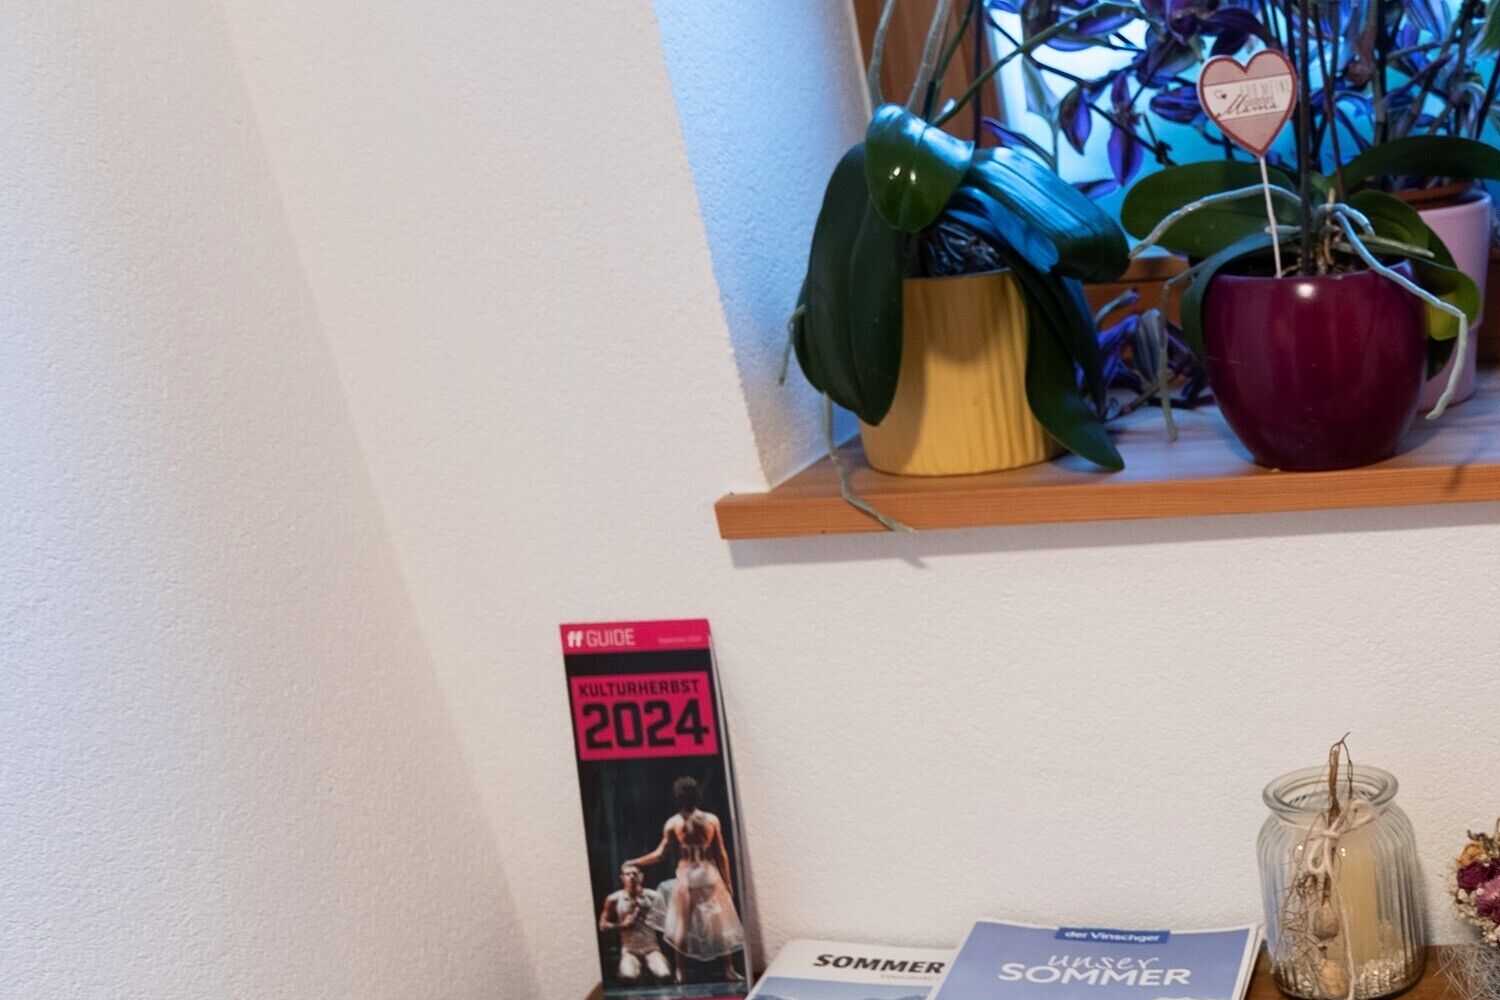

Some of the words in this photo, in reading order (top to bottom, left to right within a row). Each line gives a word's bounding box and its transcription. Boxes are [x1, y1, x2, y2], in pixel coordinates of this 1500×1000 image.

[585, 628, 636, 648] GUIDE
[579, 680, 699, 698] KULTURHERBST
[582, 698, 709, 749] 2024
[813, 953, 945, 974] SOMMER
[1048, 954, 1158, 970] unser
[999, 963, 1191, 986] SOMMER
